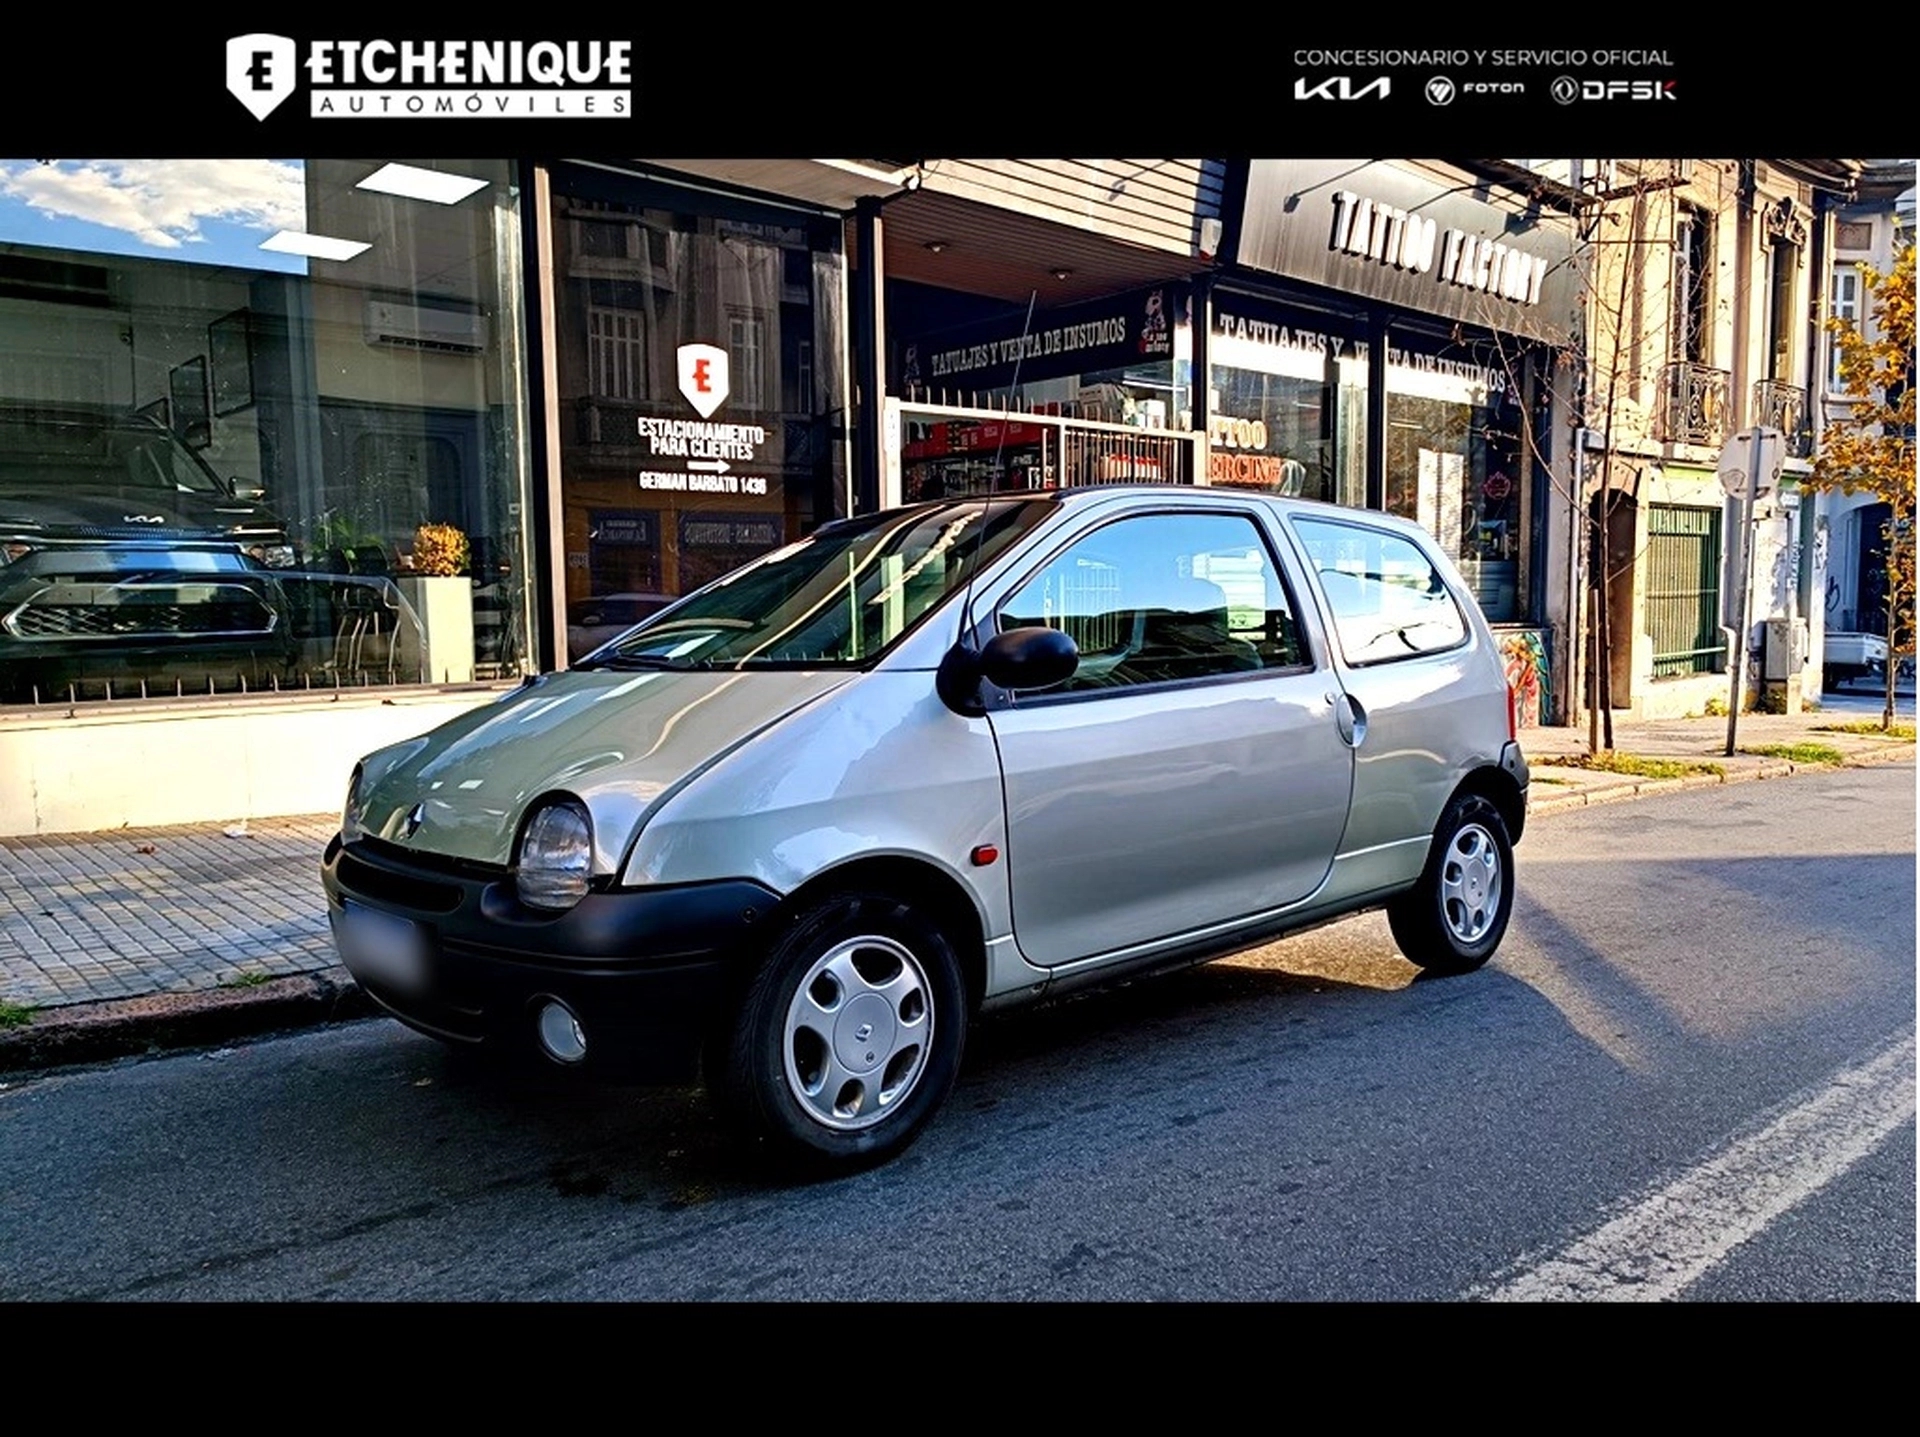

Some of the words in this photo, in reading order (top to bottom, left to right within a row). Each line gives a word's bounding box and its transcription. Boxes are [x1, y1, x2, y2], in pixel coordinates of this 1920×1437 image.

[1334, 191, 1436, 273] TATTOO
[1441, 228, 1548, 305] FACTORY
[931, 345, 989, 377] TATUAJES
[989, 341, 999, 365] Y
[1000, 332, 1042, 363] VENTA
[1043, 329, 1061, 355] DE
[1063, 316, 1126, 351] INSUMOS
[1330, 336, 1344, 362] Y
[638, 417, 764, 444] ESTACIONAMIENTO
[650, 436, 689, 456] PARA
[690, 440, 754, 460] CLIENTES
[640, 471, 687, 491] GERMAN
[688, 474, 738, 493] BARBATO
[1210, 452, 1282, 485] ERCING
